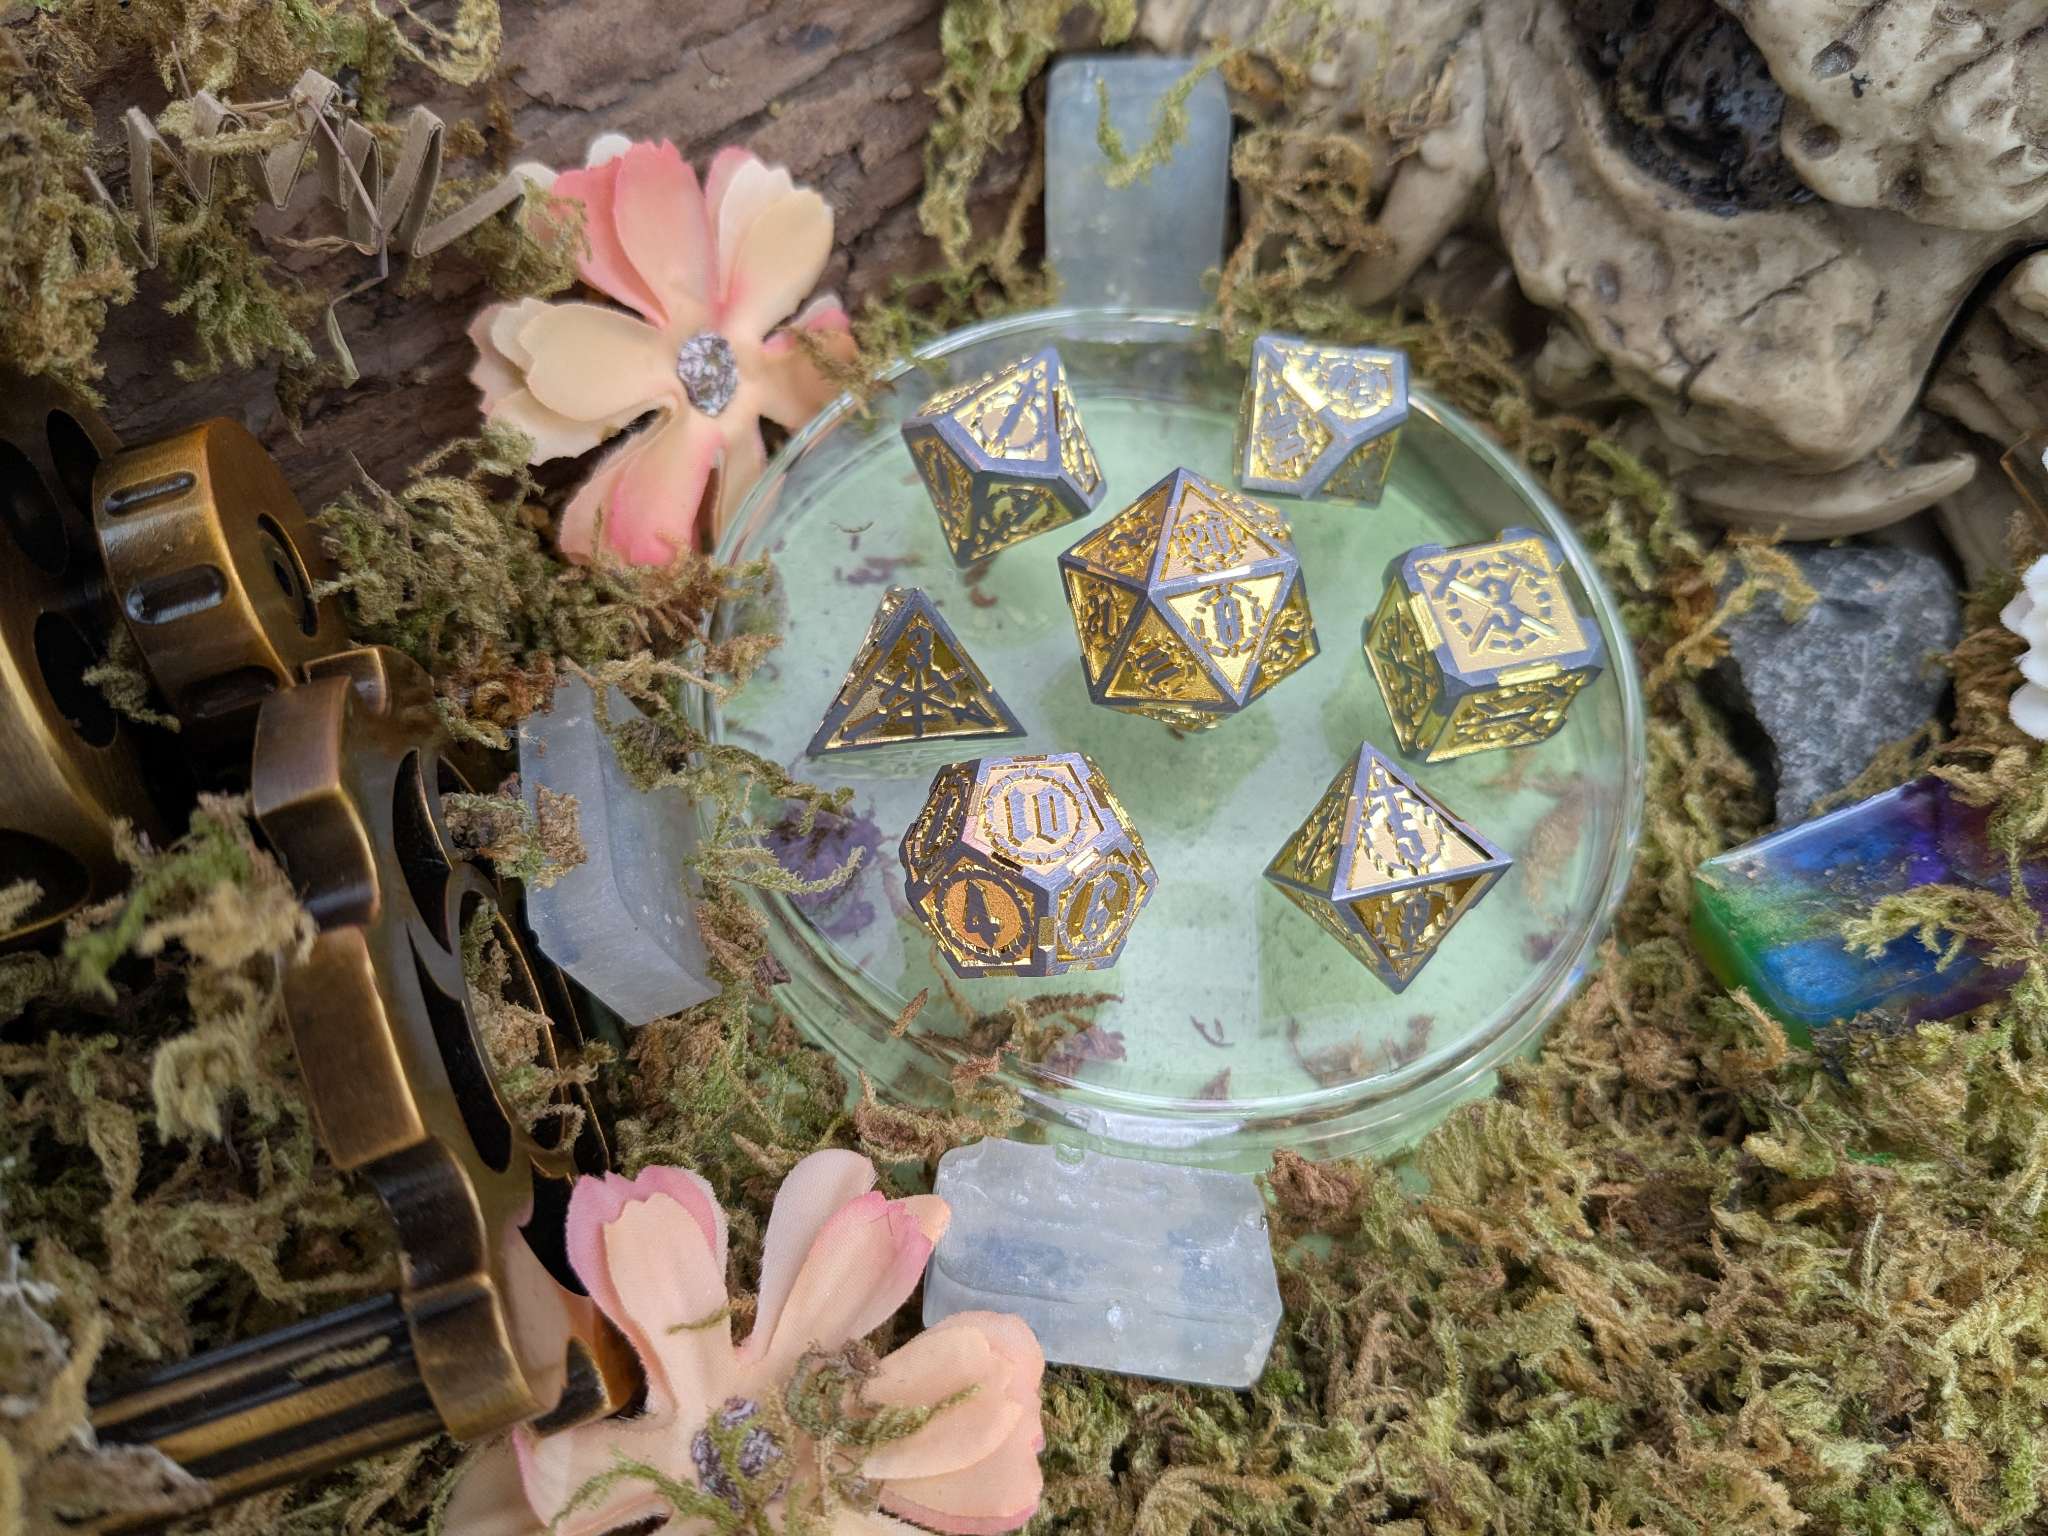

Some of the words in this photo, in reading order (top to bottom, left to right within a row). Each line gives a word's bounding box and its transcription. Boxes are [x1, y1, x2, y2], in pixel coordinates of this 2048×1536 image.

[1186, 519, 1231, 557] 20
[1215, 594, 1242, 645] 8
[908, 627, 930, 667] 3
[1008, 786, 1069, 843] 10
[965, 879, 1000, 946] 4
[1081, 871, 1117, 939] 6
